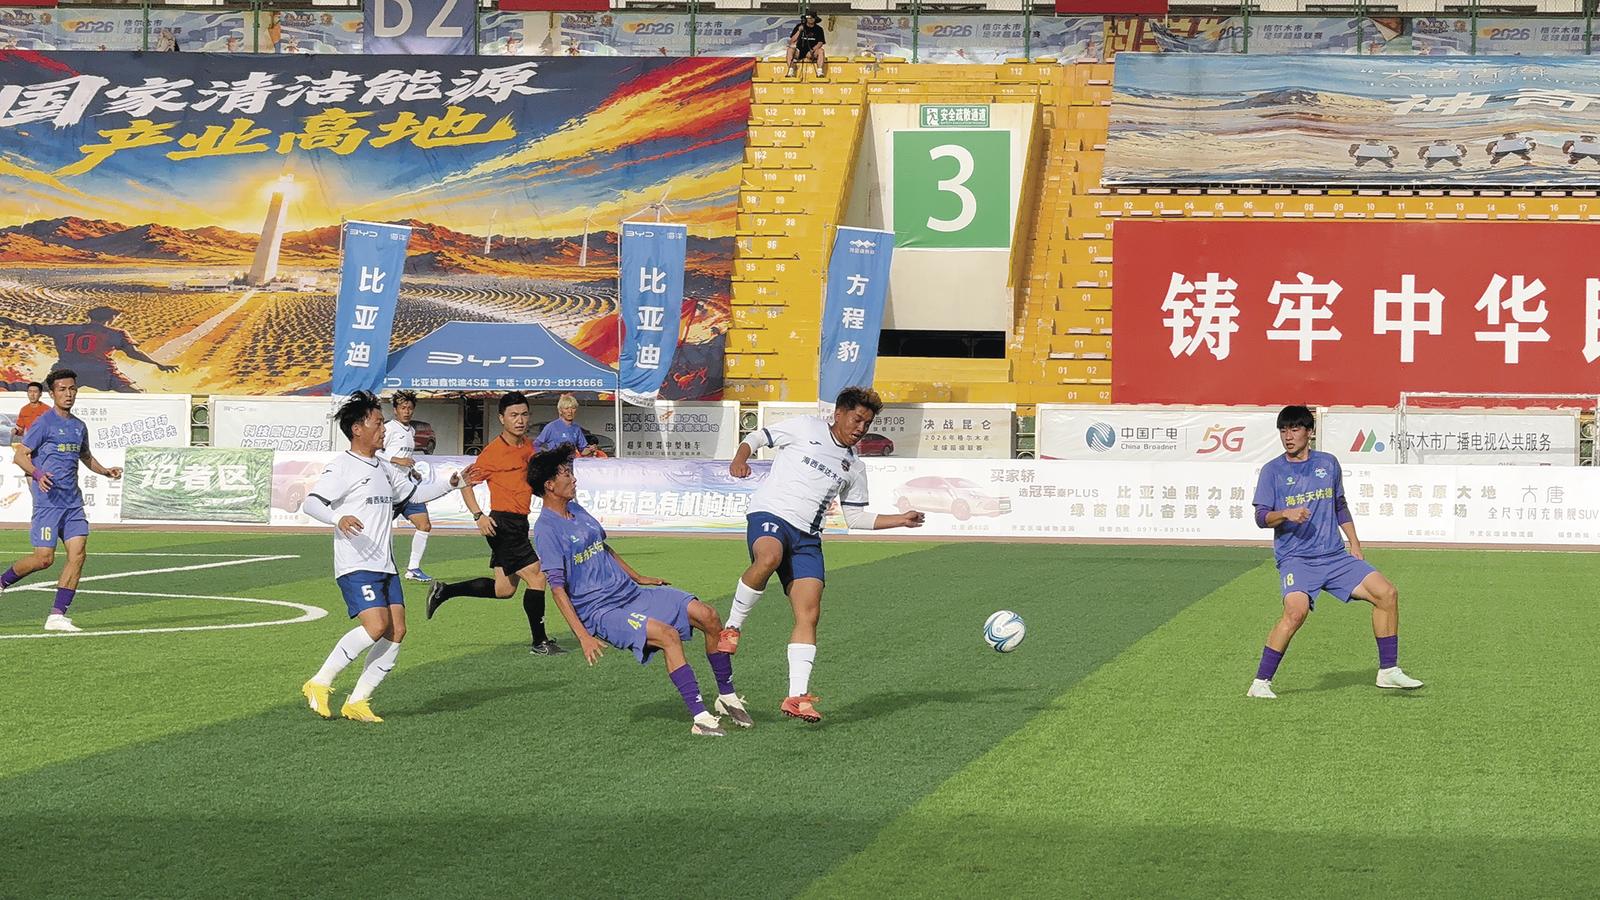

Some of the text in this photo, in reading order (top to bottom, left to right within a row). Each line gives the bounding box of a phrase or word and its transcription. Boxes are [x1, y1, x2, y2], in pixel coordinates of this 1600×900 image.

[75, 21, 114, 33] 2026
[635, 23, 674, 35] 2026
[933, 25, 973, 37] 2026
[1219, 26, 1253, 38] 2026
[1489, 28, 1530, 40] 2026
[0, 62, 548, 129] 国家清洁能源
[50, 106, 517, 176] 产业高地
[927, 144, 978, 233] 3
[345, 266, 386, 367] 比亚迪
[634, 267, 666, 370] 比亚迪
[837, 274, 870, 363] 方程豹
[1161, 271, 1600, 364] 铸牢中华
[64, 332, 96, 353] 10
[427, 351, 544, 367] BYD
[524, 378, 603, 387] 0979-8913666
[923, 419, 992, 430] 决战昆仑
[1121, 427, 1177, 440] 中国广电
[1196, 424, 1246, 454] 5G
[138, 463, 255, 491] 记者区
[991, 469, 1035, 482] 买家轿
[1360, 483, 1496, 499] 驰骋高原大地
[576, 489, 753, 517] 全域绿色有机枸杞
[1071, 504, 1243, 519] 绿茵健儿奋勇争锋
[41, 526, 51, 540] 16
[761, 522, 779, 533] 17
[361, 584, 376, 601] 5
[627, 612, 647, 630] 45
